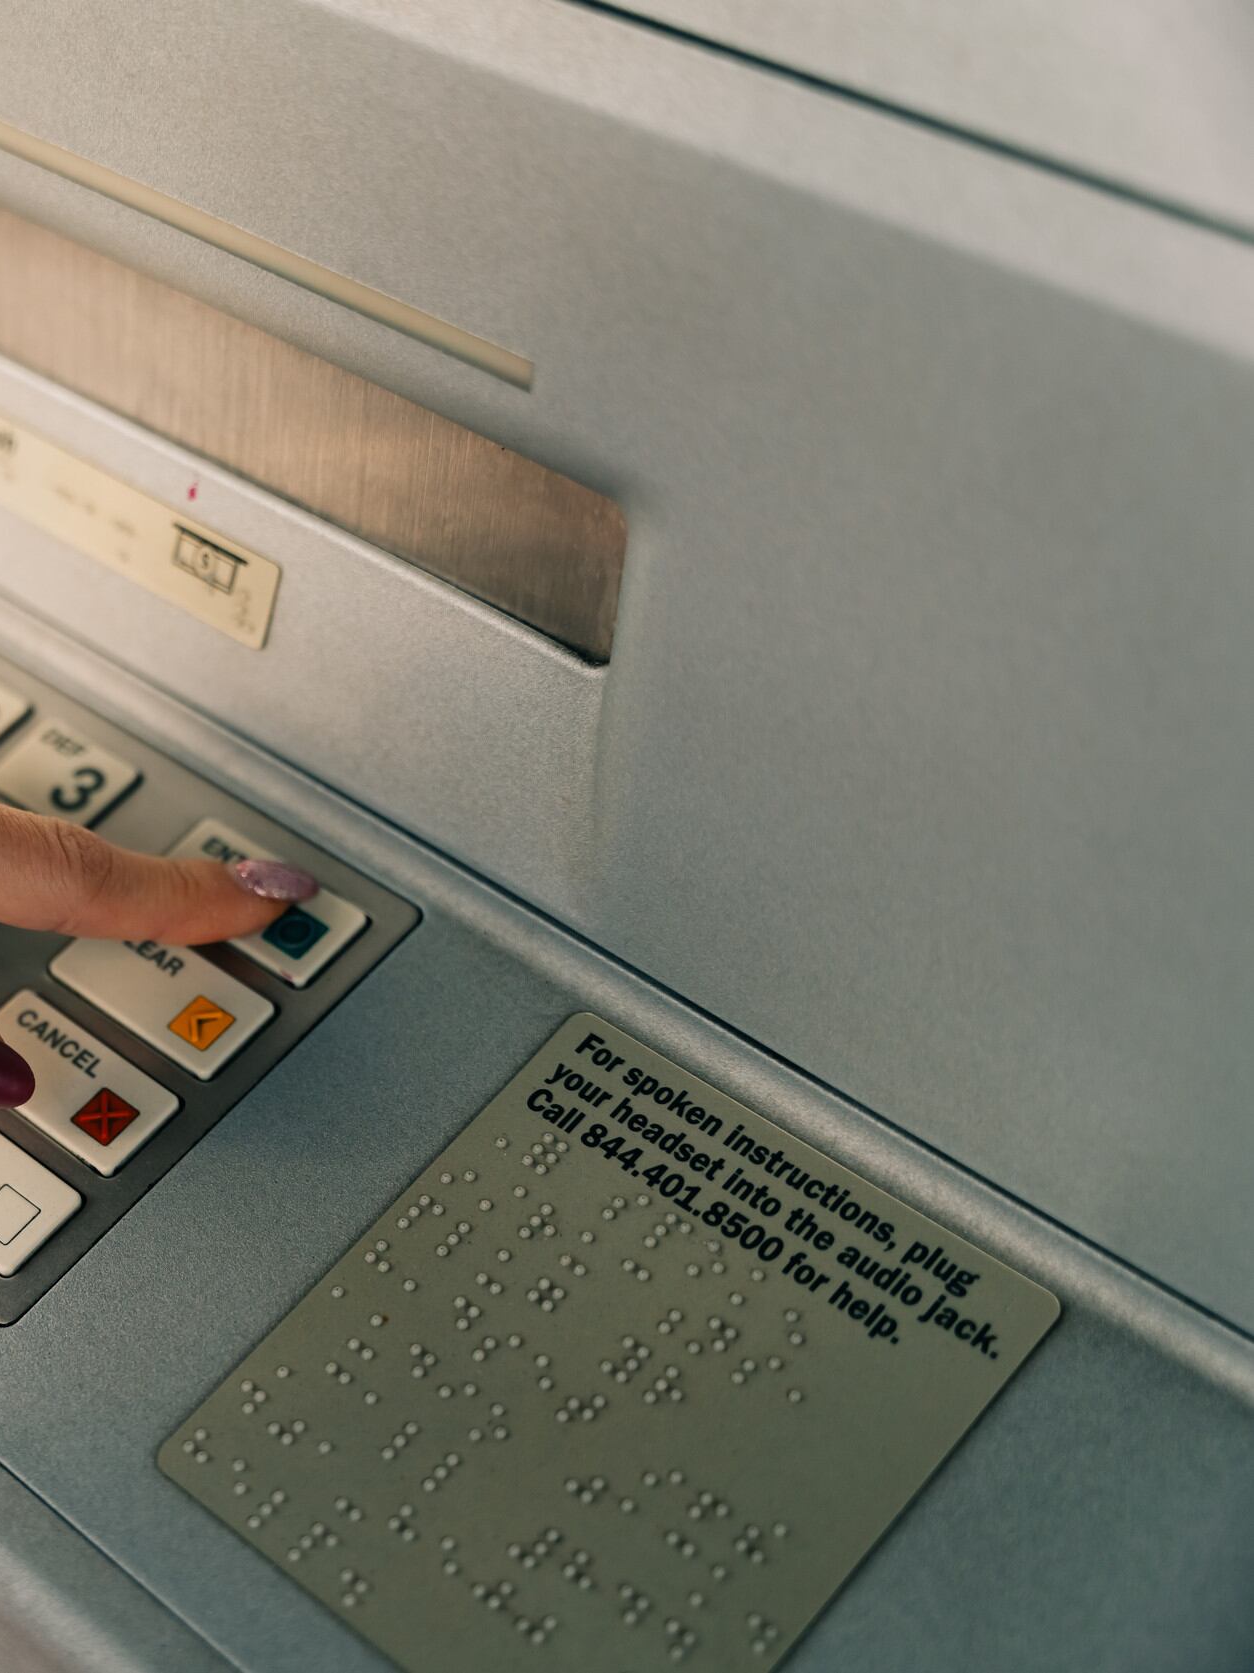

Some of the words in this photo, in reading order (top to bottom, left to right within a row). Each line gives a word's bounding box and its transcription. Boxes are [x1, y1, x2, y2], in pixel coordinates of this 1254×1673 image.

[50, 767, 106, 812] 3
[16, 1008, 101, 1079] CANCEL
[575, 1033, 625, 1073] For
[622, 1066, 723, 1136] spoken
[724, 1122, 896, 1252] instructions,
[901, 1239, 981, 1297] plug
[526, 1088, 585, 1133] Call
[580, 1123, 785, 1264] 844.401.8500
[782, 1251, 831, 1294] for
[828, 1281, 901, 1345] help.
[545, 1062, 612, 1107] your
[610, 1097, 725, 1181] headset
[722, 1168, 782, 1219] into
[785, 1207, 835, 1251] the
[837, 1246, 923, 1306] audio
[918, 1295, 1000, 1360] jack.
